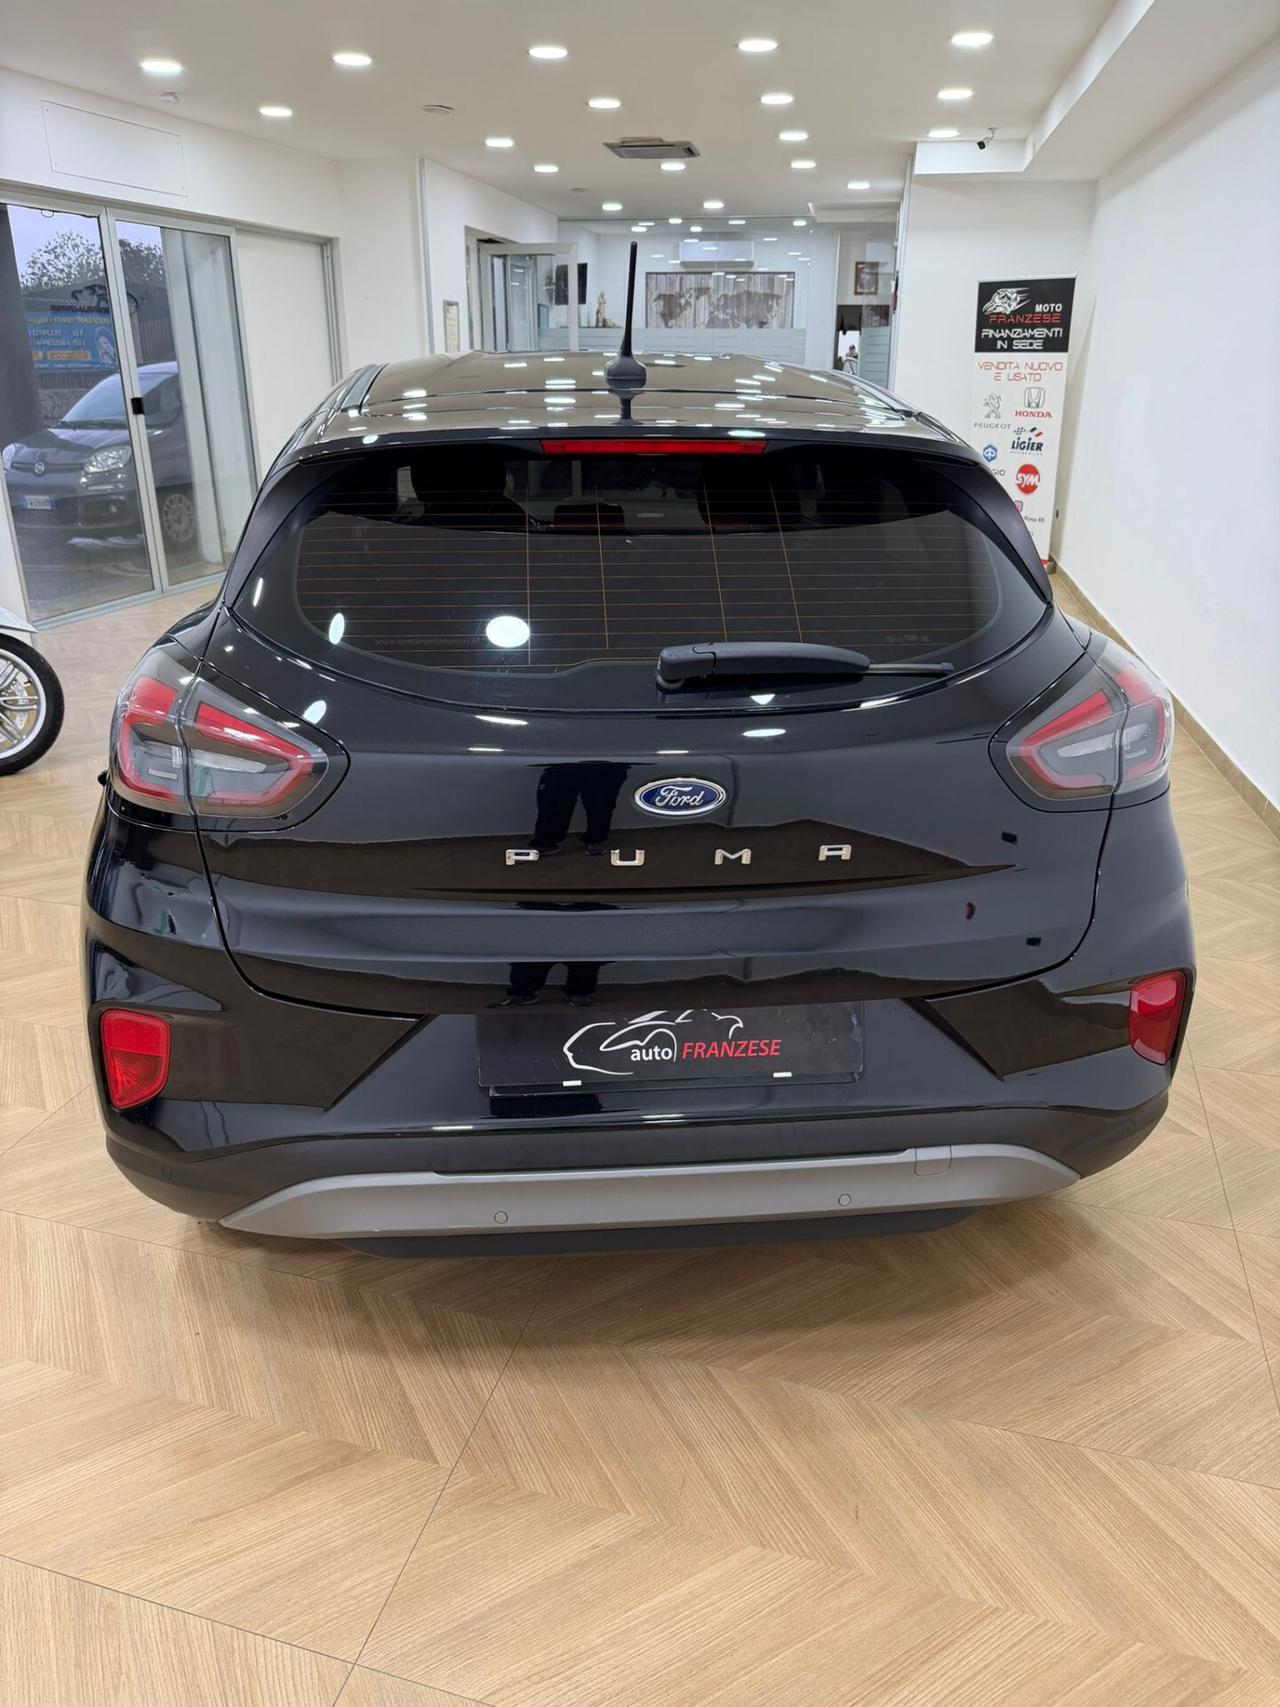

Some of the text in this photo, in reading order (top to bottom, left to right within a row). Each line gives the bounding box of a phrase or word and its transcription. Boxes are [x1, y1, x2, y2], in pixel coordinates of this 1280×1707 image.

[1035, 303, 1062, 312] MOTO
[988, 313, 1062, 324] FRANZESE
[981, 328, 1063, 338] FINANZIAMENTI
[996, 340, 1044, 349] IN SEDE
[978, 361, 1064, 371] VENDITA NUOVO
[993, 372, 1042, 382] E USATO
[1015, 410, 1053, 418] HONDA
[974, 422, 1011, 430] PEUGEOT
[1016, 473, 1040, 487] SYM
[655, 785, 705, 808] Ford
[505, 844, 852, 867] PUMA
[631, 1039, 782, 1062] auto FRANZESE
